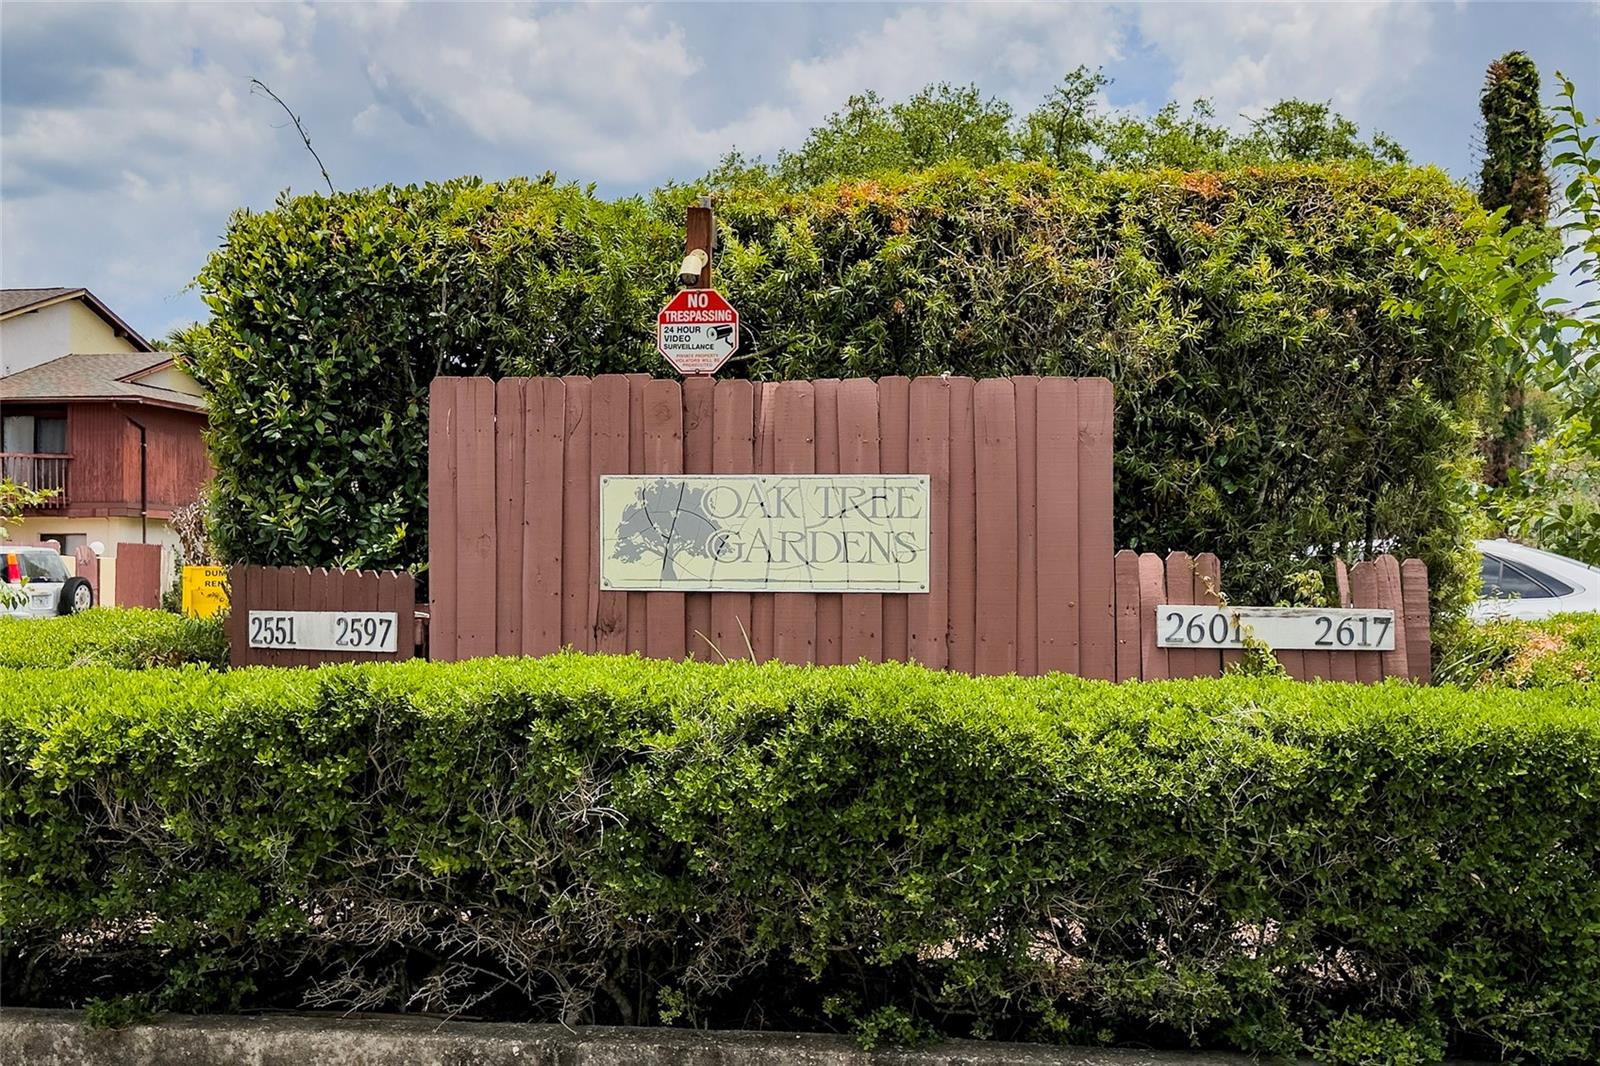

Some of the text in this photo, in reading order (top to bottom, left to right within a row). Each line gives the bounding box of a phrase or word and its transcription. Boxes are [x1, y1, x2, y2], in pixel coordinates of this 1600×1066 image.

[664, 310, 732, 322] TRESPASSING
[687, 293, 709, 308] NO
[702, 483, 923, 525] OAK TREE
[705, 528, 918, 568] GARDENS
[250, 617, 392, 648] 2551 2597
[1165, 612, 1392, 648] 2601 2617
